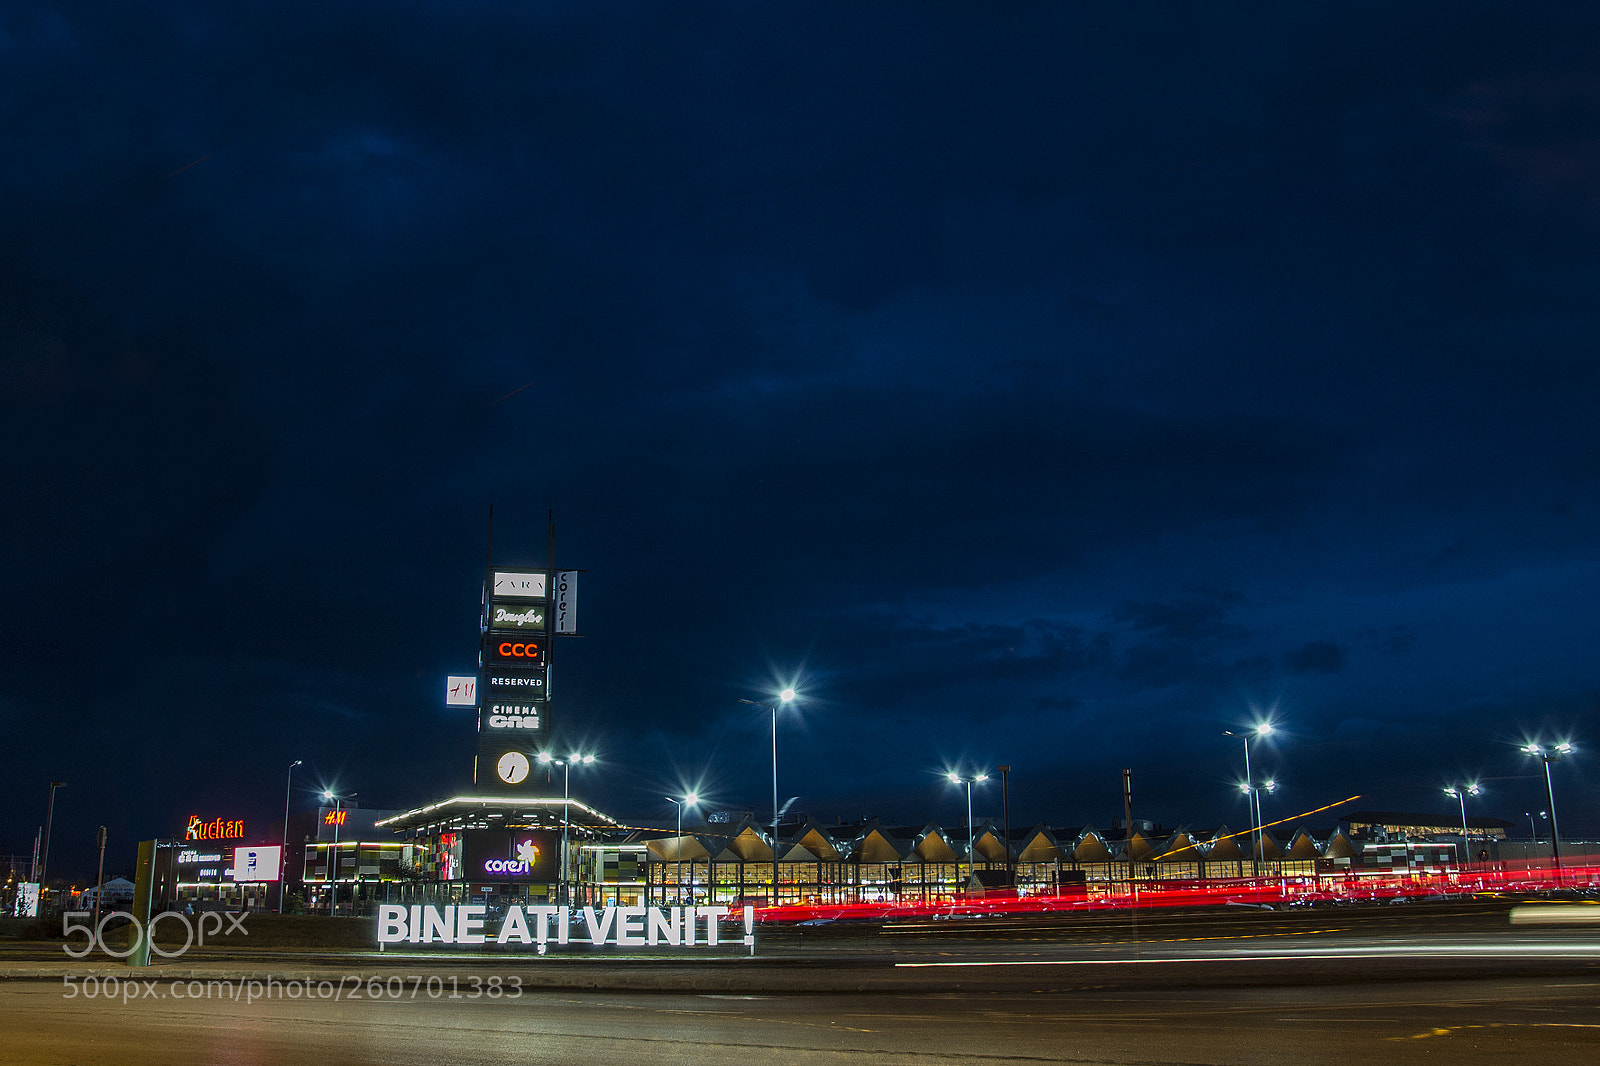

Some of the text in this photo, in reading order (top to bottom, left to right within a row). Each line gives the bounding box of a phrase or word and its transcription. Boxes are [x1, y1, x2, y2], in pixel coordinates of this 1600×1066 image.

[494, 608, 543, 626] Douglas
[498, 642, 538, 658] CCC
[491, 677, 542, 686] RESERVED
[450, 683, 474, 698] HM
[492, 705, 537, 715] CINEMA
[185, 815, 245, 841] Auchan
[484, 858, 530, 876] coresi
[377, 904, 486, 944] BINE
[583, 905, 729, 946] VENIT
